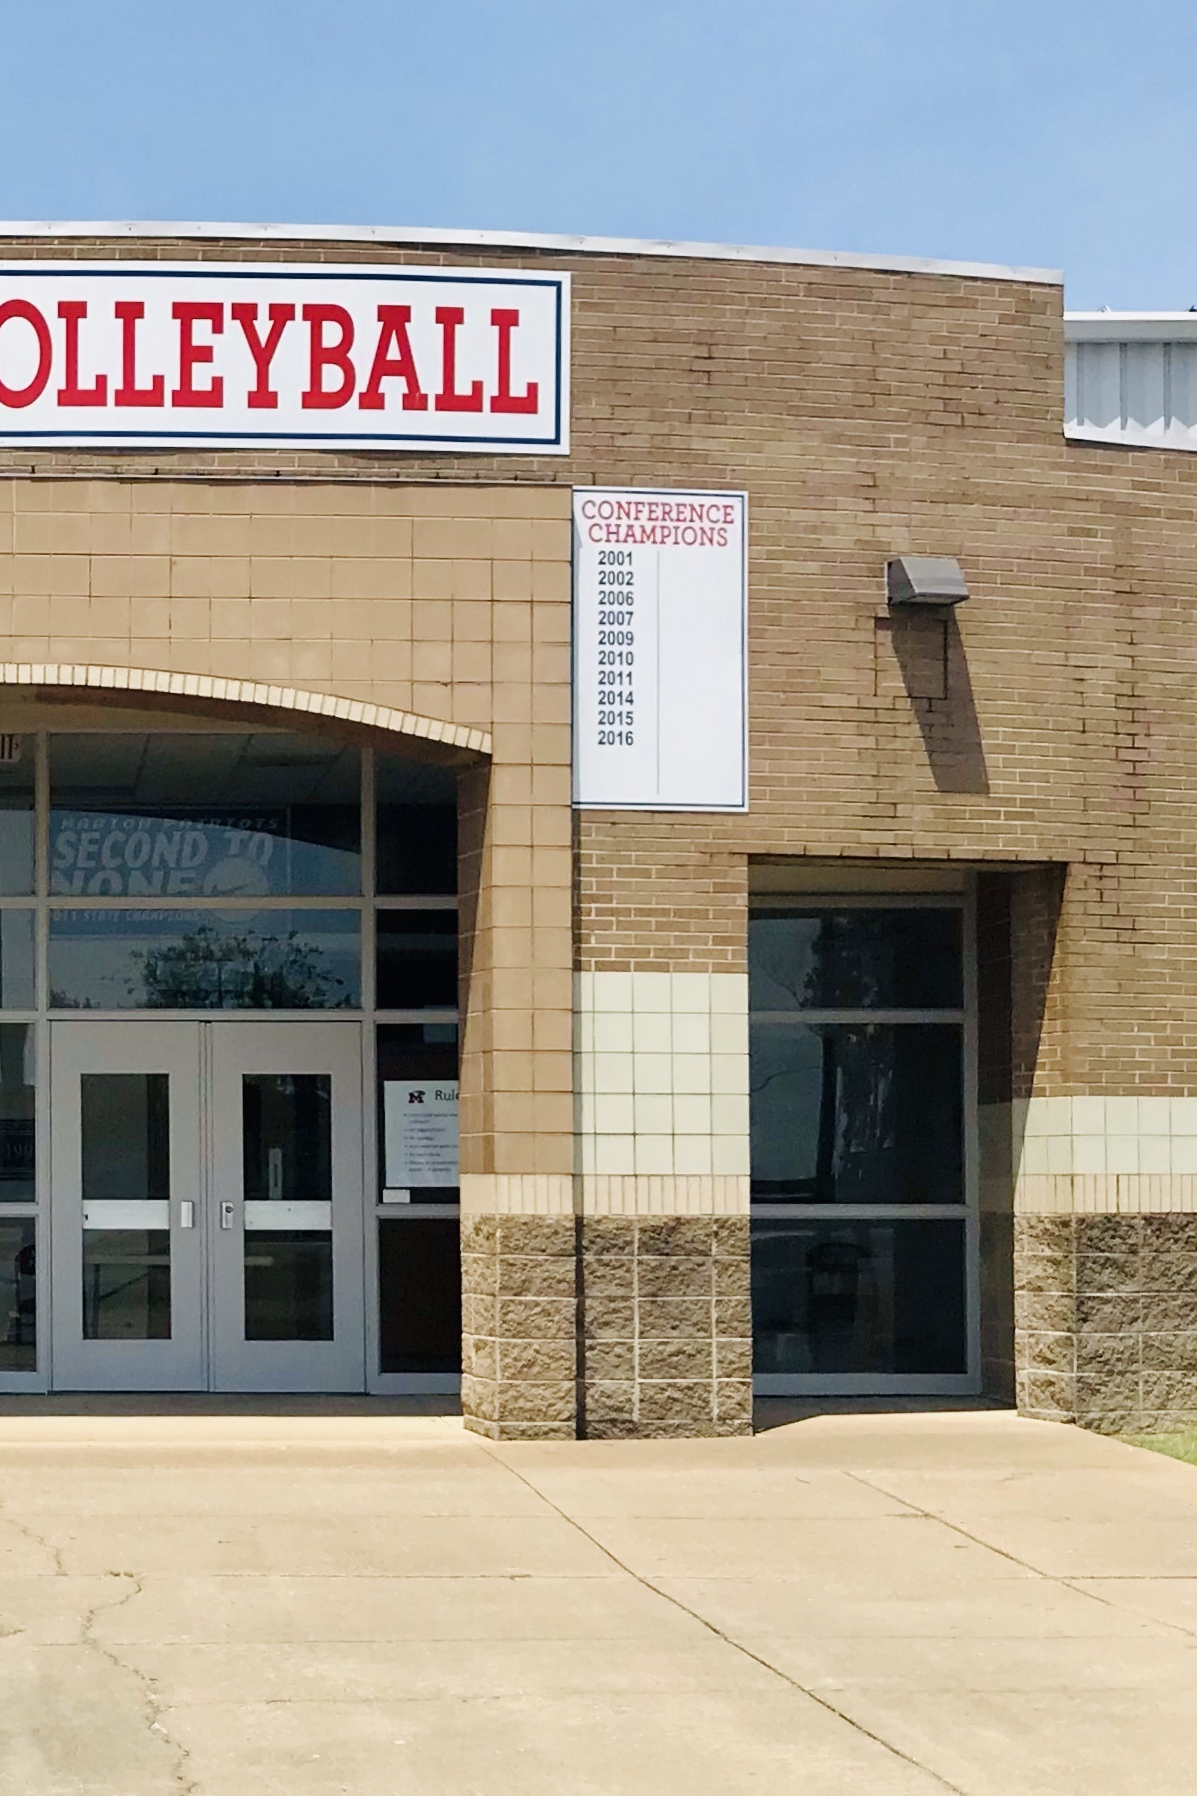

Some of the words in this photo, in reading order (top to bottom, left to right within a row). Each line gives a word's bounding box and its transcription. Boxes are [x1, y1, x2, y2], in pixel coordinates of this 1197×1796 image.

[582, 500, 734, 524] CONFERENCE
[589, 523, 727, 547] CHAMPIONS
[598, 551, 632, 565] 2001
[599, 571, 633, 586] 2002
[599, 591, 633, 606] 2006
[599, 611, 633, 625] 2007
[599, 630, 634, 646] 2009
[599, 650, 633, 666] 2010
[598, 671, 632, 685] 2011
[598, 690, 634, 705] 2014
[598, 710, 633, 725] 2015
[598, 730, 633, 745] 2016
[52, 830, 209, 869] SECOND
[224, 829, 274, 867] TO
